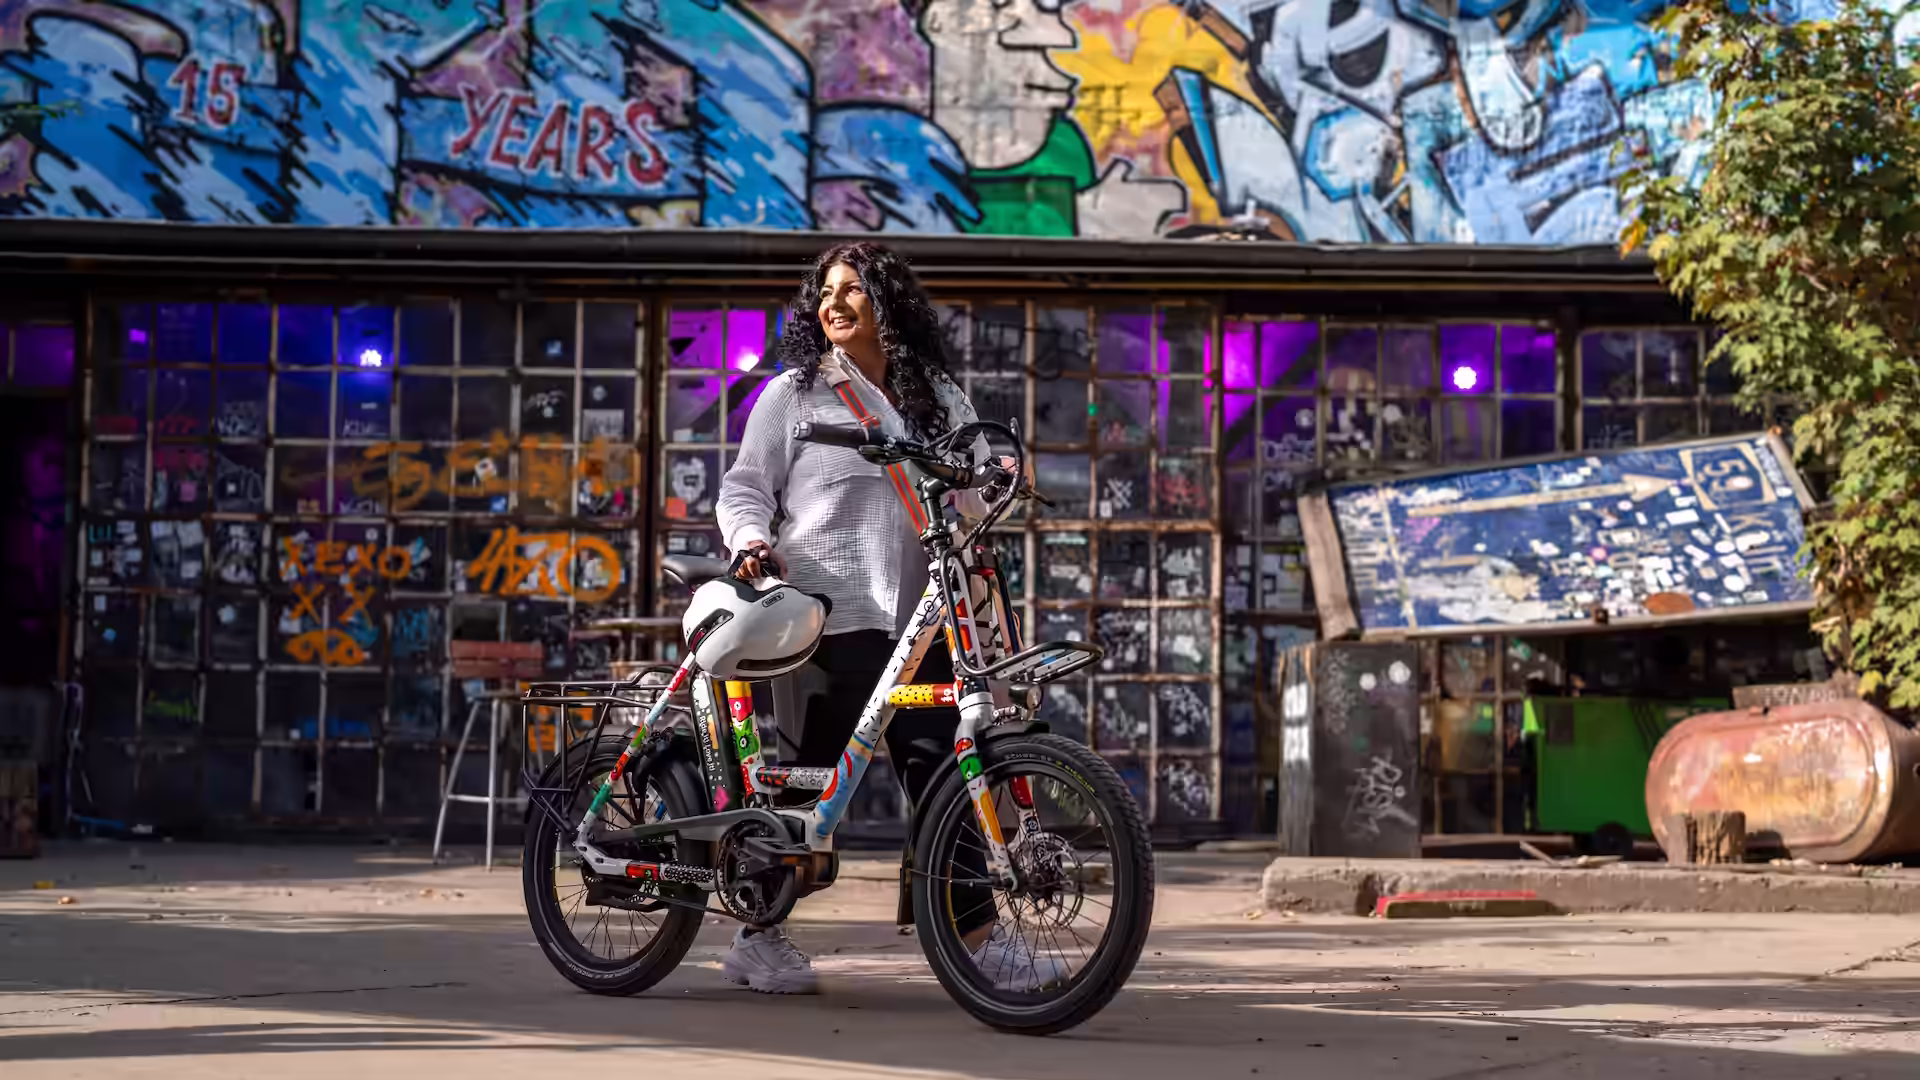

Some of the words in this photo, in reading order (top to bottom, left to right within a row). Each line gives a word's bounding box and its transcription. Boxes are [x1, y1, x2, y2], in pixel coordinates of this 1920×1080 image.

[167, 54, 246, 129] 15
[450, 82, 669, 189] YEARS
[1728, 512, 1788, 575] Kln
